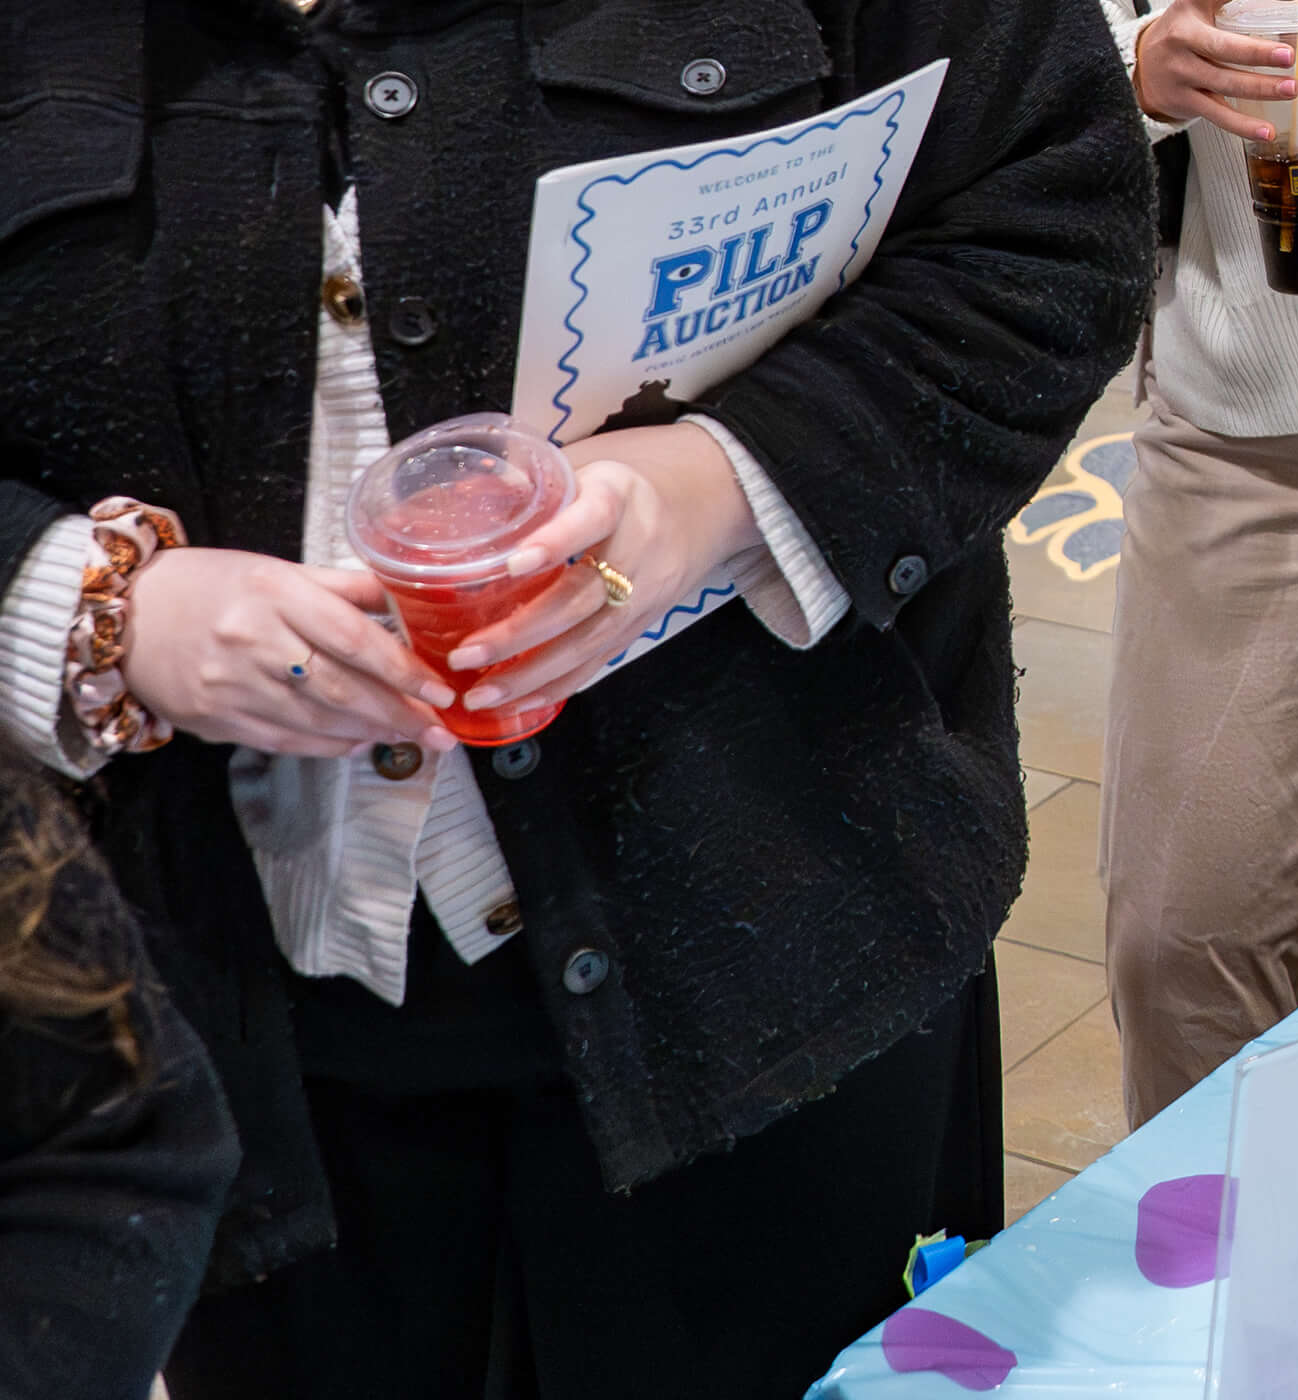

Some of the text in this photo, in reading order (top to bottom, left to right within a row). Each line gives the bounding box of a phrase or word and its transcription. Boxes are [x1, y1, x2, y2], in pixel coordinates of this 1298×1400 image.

[667, 161, 849, 241] 33rd Annual
[698, 143, 836, 195] WELCOME TO THE
[631, 252, 823, 362] AUCTION
[642, 198, 834, 323] PILP
